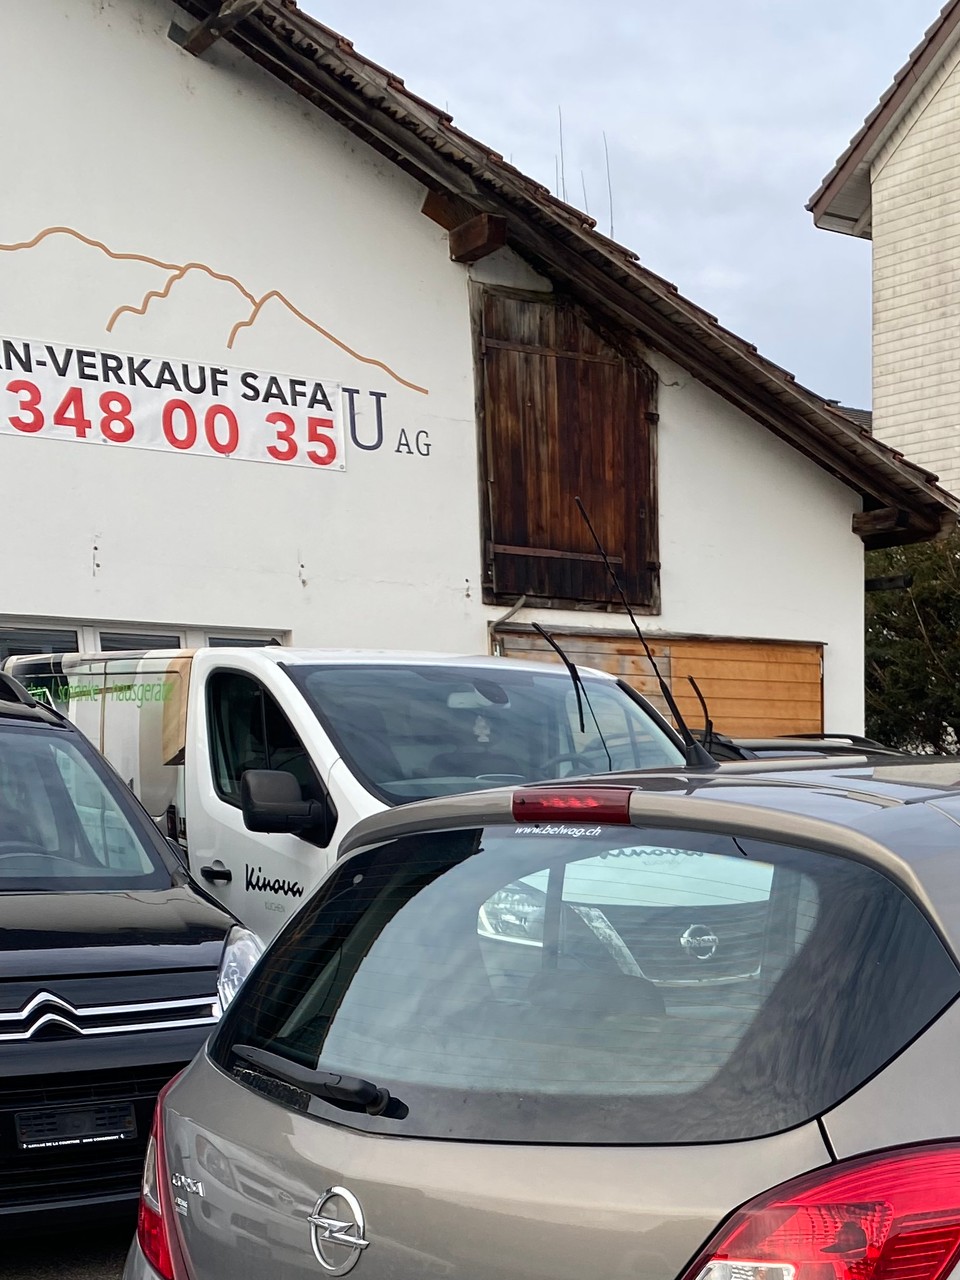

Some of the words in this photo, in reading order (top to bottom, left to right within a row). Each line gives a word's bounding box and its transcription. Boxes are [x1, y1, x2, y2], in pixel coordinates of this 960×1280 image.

[0, 340, 229, 397] N-VERKAUF
[241, 372, 333, 412] SAFA
[5, 379, 136, 443] 348
[162, 399, 239, 455] 00
[265, 411, 337, 466] 35
[395, 428, 432, 457] AG
[514, 825, 602, 838] www.belwag.ch
[245, 863, 304, 898] Kinova
